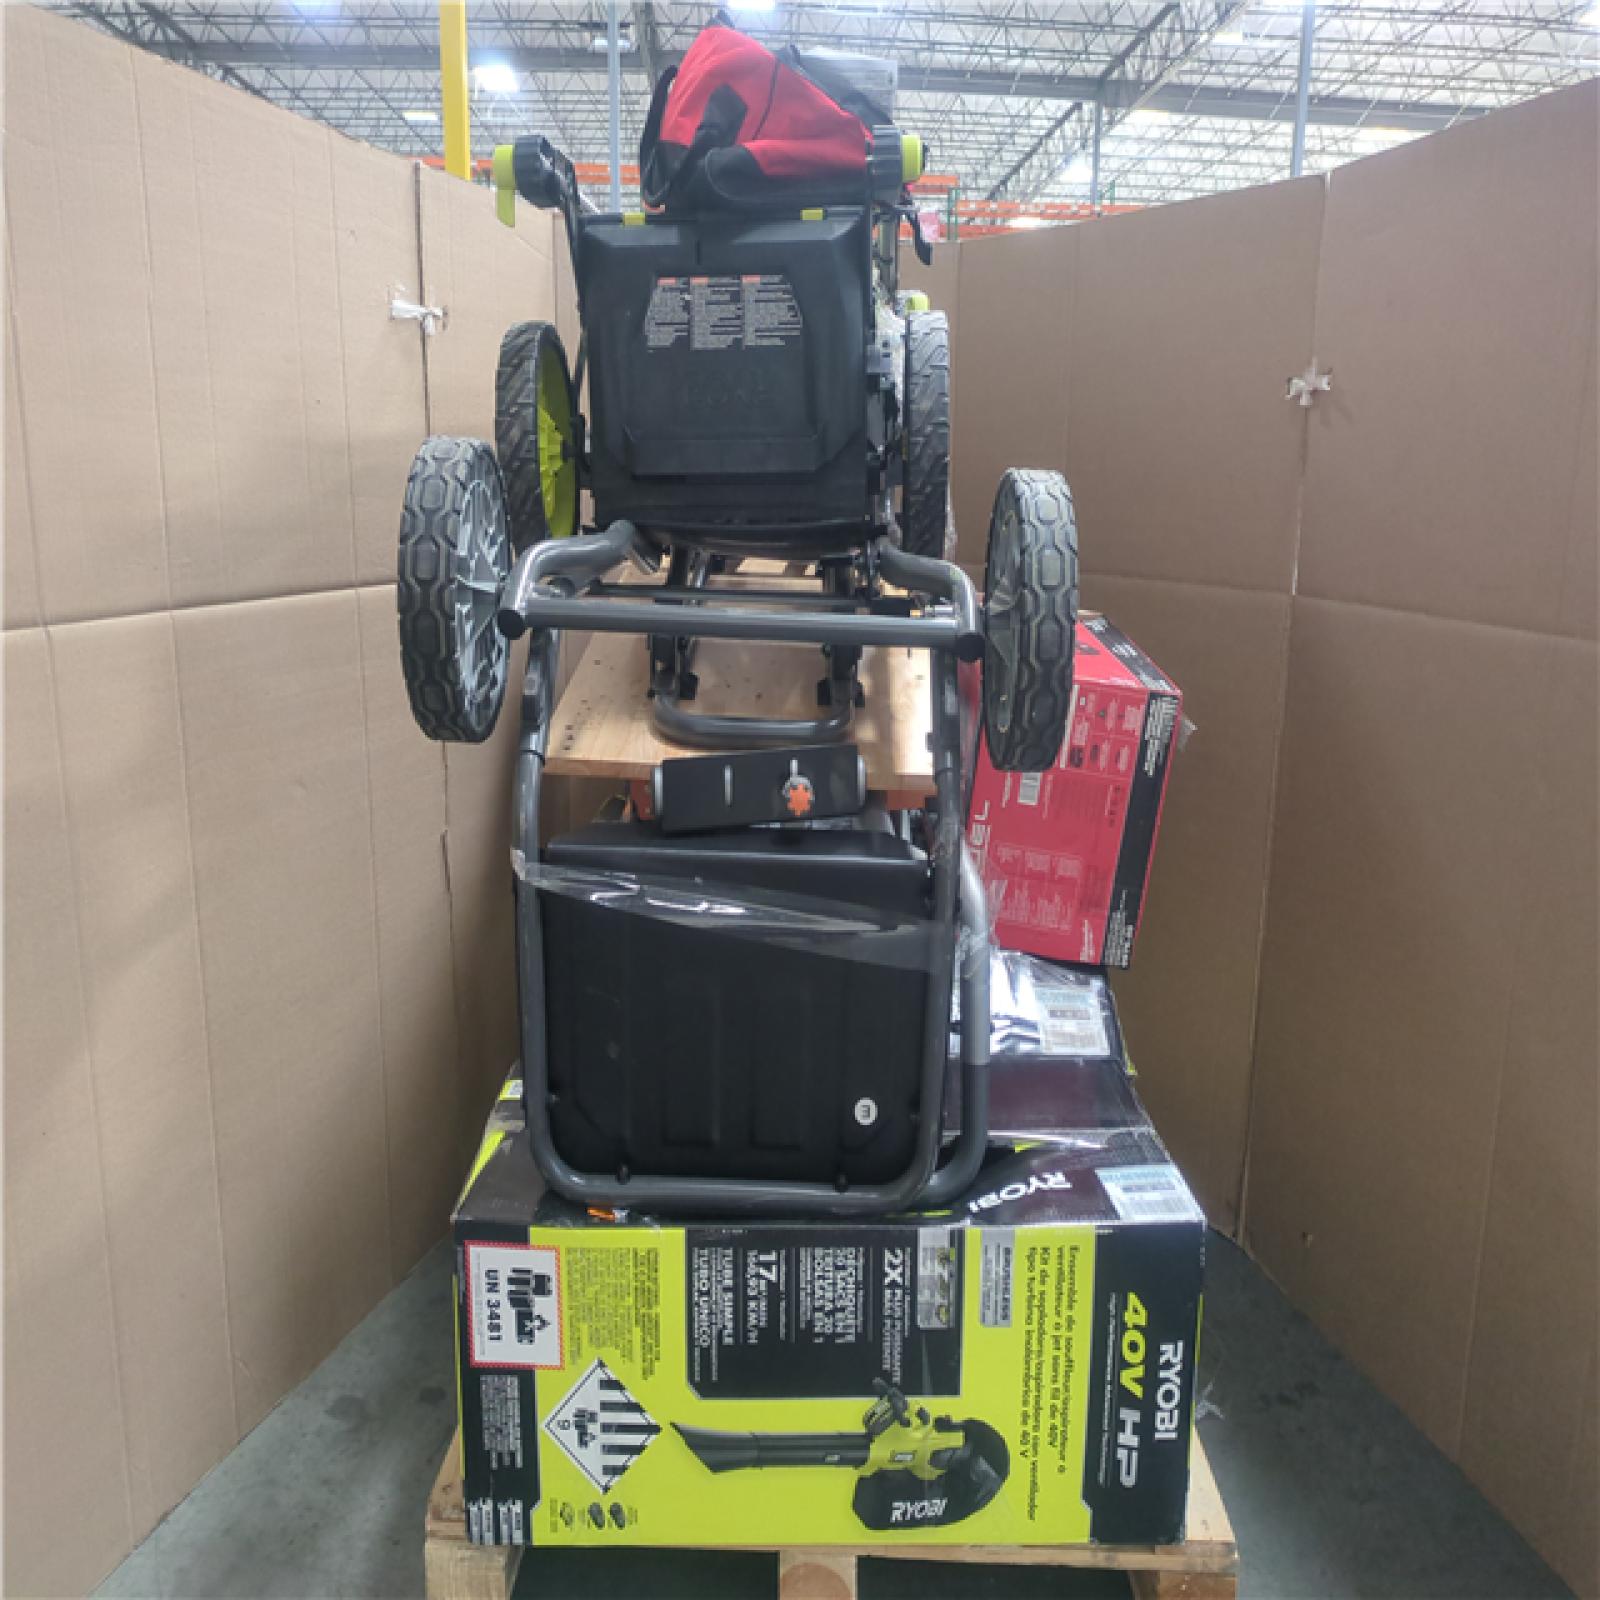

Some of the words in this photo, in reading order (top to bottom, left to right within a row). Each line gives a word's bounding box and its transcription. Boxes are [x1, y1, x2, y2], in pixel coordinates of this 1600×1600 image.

[968, 1172, 1072, 1213] RYOBI
[760, 1249, 779, 1283] 17
[885, 1247, 904, 1286] 2X
[1025, 1247, 1036, 1273] tipo
[1040, 1247, 1050, 1265] Kit
[486, 1269, 499, 1294] UN
[1040, 1269, 1049, 1285] de
[1068, 1245, 1079, 1311] Ensemble
[488, 1299, 502, 1342] 3481
[1066, 1315, 1075, 1333] de
[1051, 1335, 1061, 1350] jet
[1121, 1291, 1148, 1400] 40V
[1052, 1355, 1060, 1385] sans
[1155, 1339, 1183, 1440] RYOBI
[1022, 1410, 1030, 1426] de
[1050, 1404, 1059, 1420] de
[1117, 1406, 1141, 1489] HP
[889, 1497, 948, 1524] RYOBI
